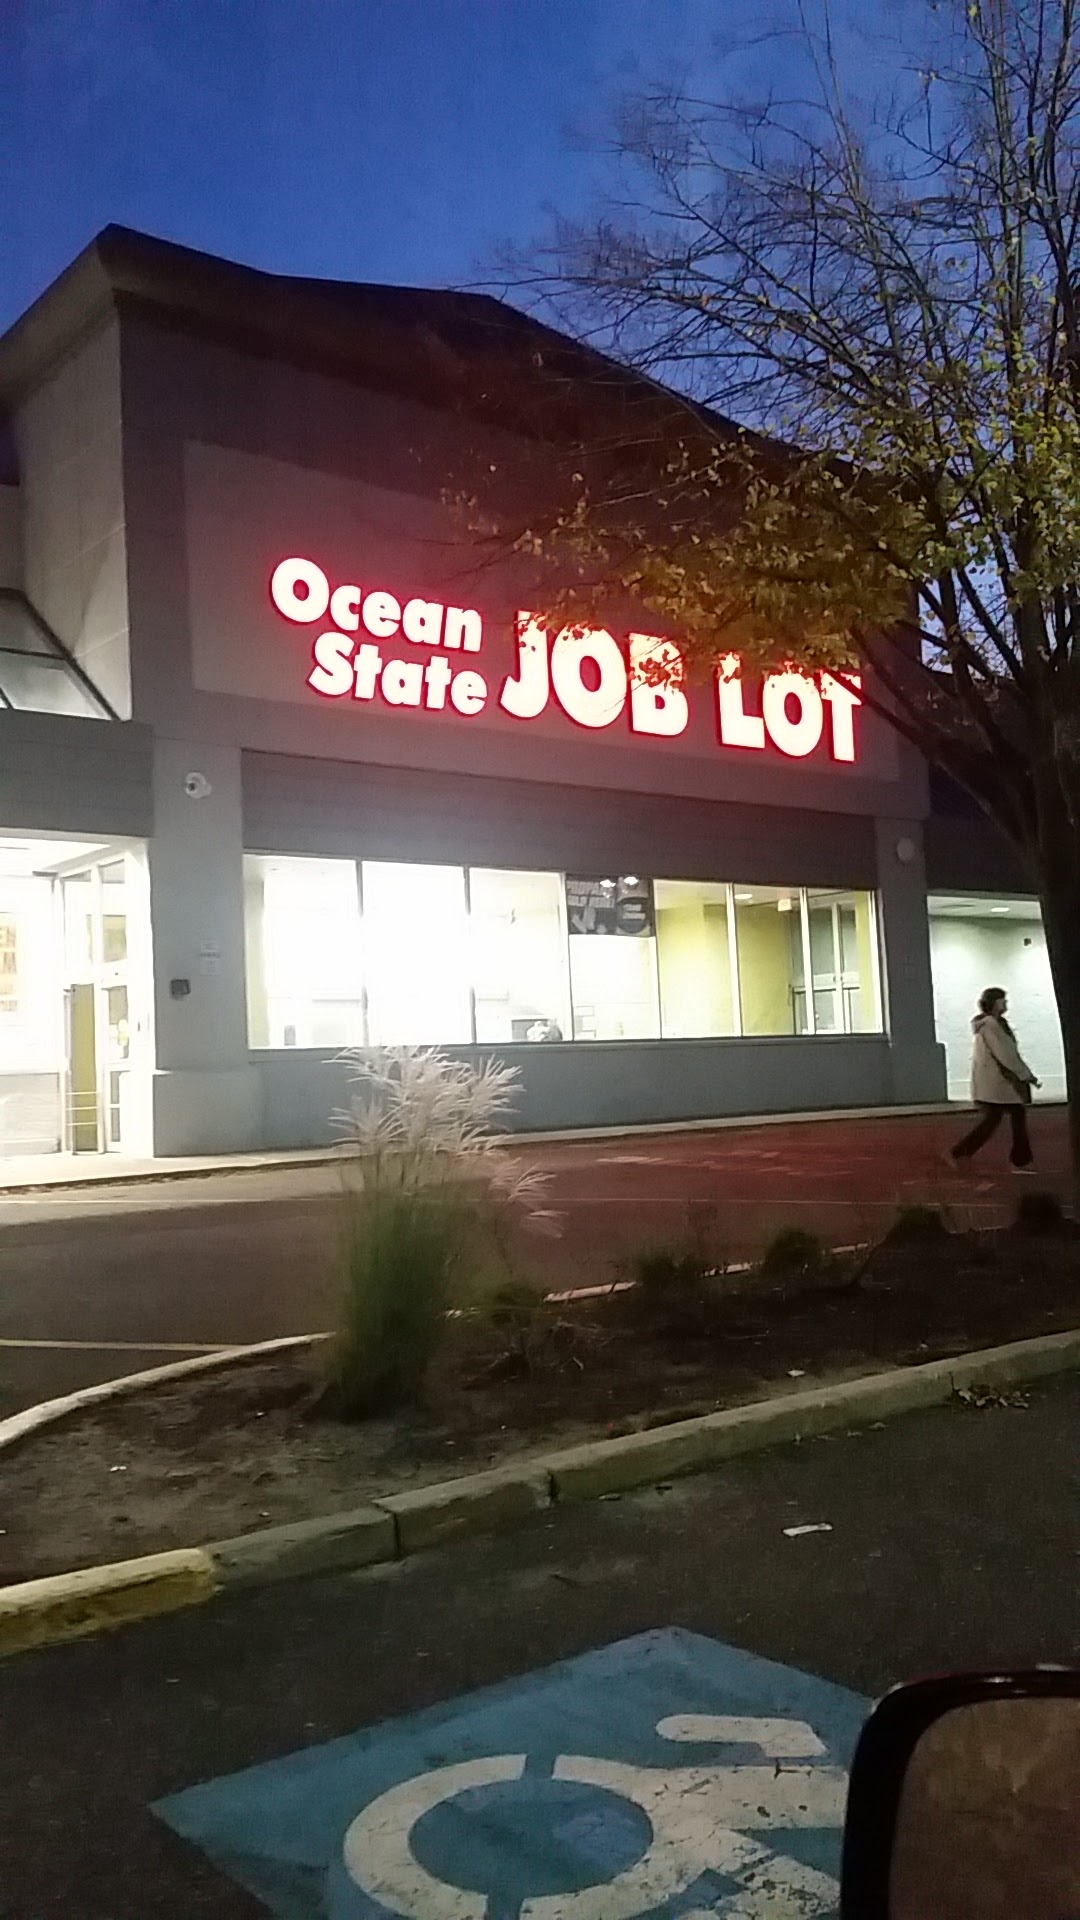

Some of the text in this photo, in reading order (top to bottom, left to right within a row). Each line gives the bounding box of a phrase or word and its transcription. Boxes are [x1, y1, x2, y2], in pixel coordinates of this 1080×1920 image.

[270, 557, 483, 653] Ocean
[307, 631, 488, 716] State
[499, 610, 863, 762] JOB LOT
